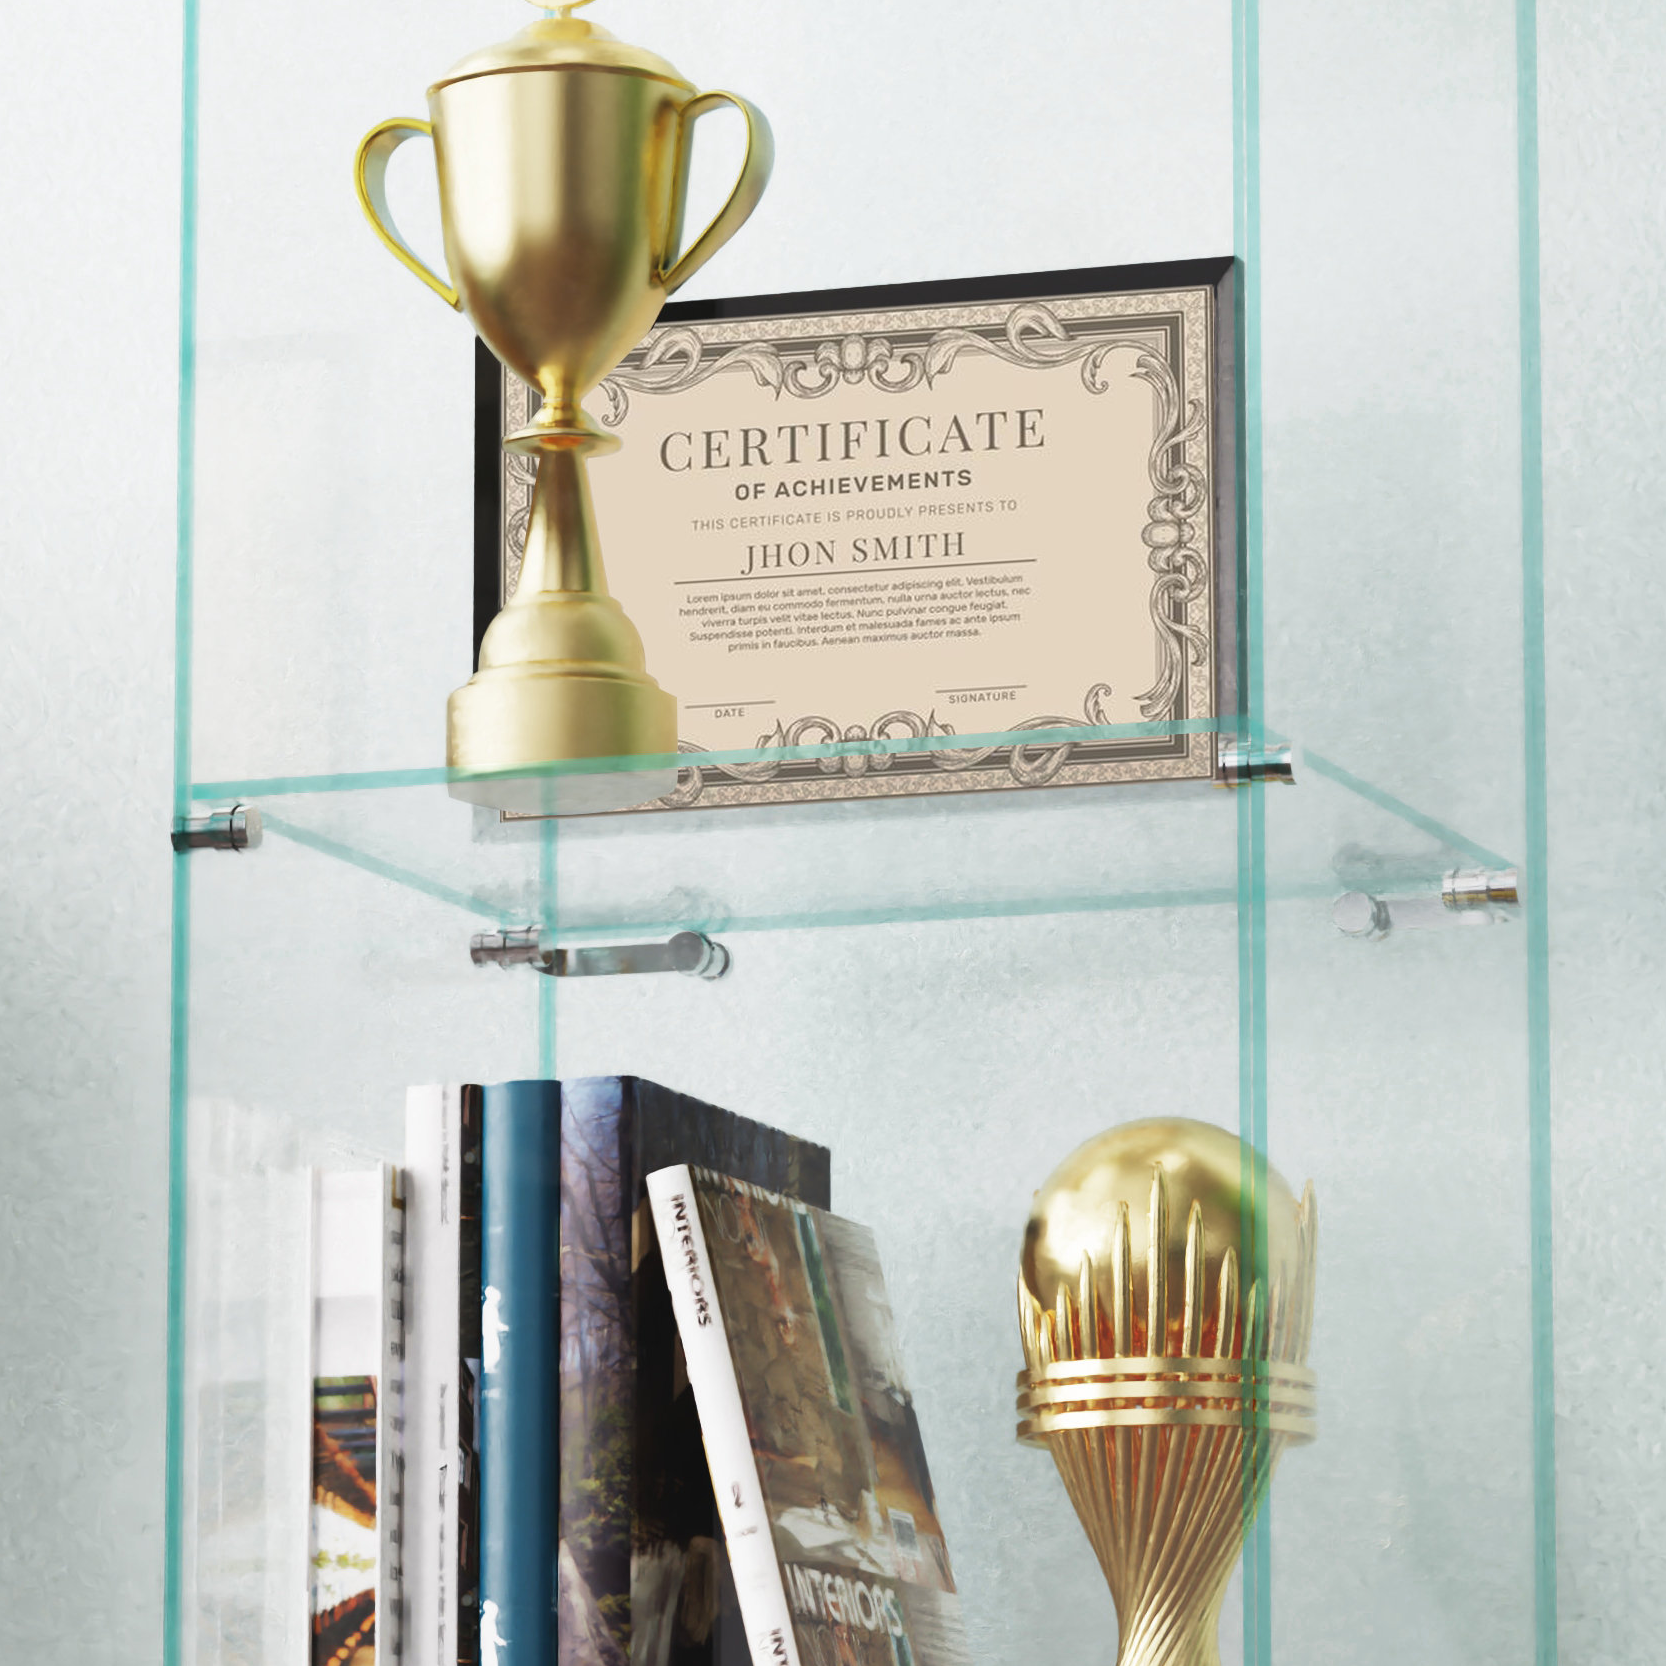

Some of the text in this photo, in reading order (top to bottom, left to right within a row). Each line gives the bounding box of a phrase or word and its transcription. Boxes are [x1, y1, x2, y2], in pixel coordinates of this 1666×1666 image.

[659, 408, 1046, 473] CERTIFICATE
[734, 468, 973, 501] OF ACHIEVEMENTS
[691, 499, 1018, 532] THIS CERTIFICATE IS PROUDLY PRESENTS TO
[740, 532, 966, 576] JHON SMITH
[686, 594, 719, 604] Lorem
[720, 591, 752, 603] ipsum
[754, 590, 779, 599] dolor
[782, 588, 795, 597] sit
[827, 581, 890, 595] consectetur
[891, 579, 944, 591] adipiscing
[965, 574, 1023, 586] Vestibulum
[730, 603, 756, 613] diam
[757, 604, 771, 612] eu
[772, 599, 824, 611] commodo
[887, 593, 912, 603] nulla
[914, 592, 938, 602] urna
[940, 590, 973, 601] auctor
[1011, 587, 1031, 596] nec
[689, 630, 754, 642] Suspendisse
[797, 624, 844, 634] Interdum
[846, 623, 857, 632] et
[858, 620, 914, 631] malesuada
[915, 617, 947, 627] fames
[949, 617, 962, 625] ac
[963, 614, 987, 624] ante
[989, 612, 1021, 623] ipsum
[701, 618, 736, 629] viverra
[738, 615, 768, 627] turpis
[769, 614, 791, 623] velit
[793, 611, 819, 621] vitae
[857, 608, 887, 619] Nunc
[886, 606, 927, 618] pulvinar
[929, 603, 968, 616] congue
[728, 641, 760, 653] primis
[762, 640, 771, 650] in
[821, 635, 860, 645] Aenean
[862, 632, 908, 643] maximus
[910, 629, 944, 640] auctor
[948, 690, 1017, 705] SIGNATURE
[714, 707, 745, 719] DATE
[670, 1193, 712, 1328] INTERIORS
[785, 1562, 903, 1637] INTERIORS
